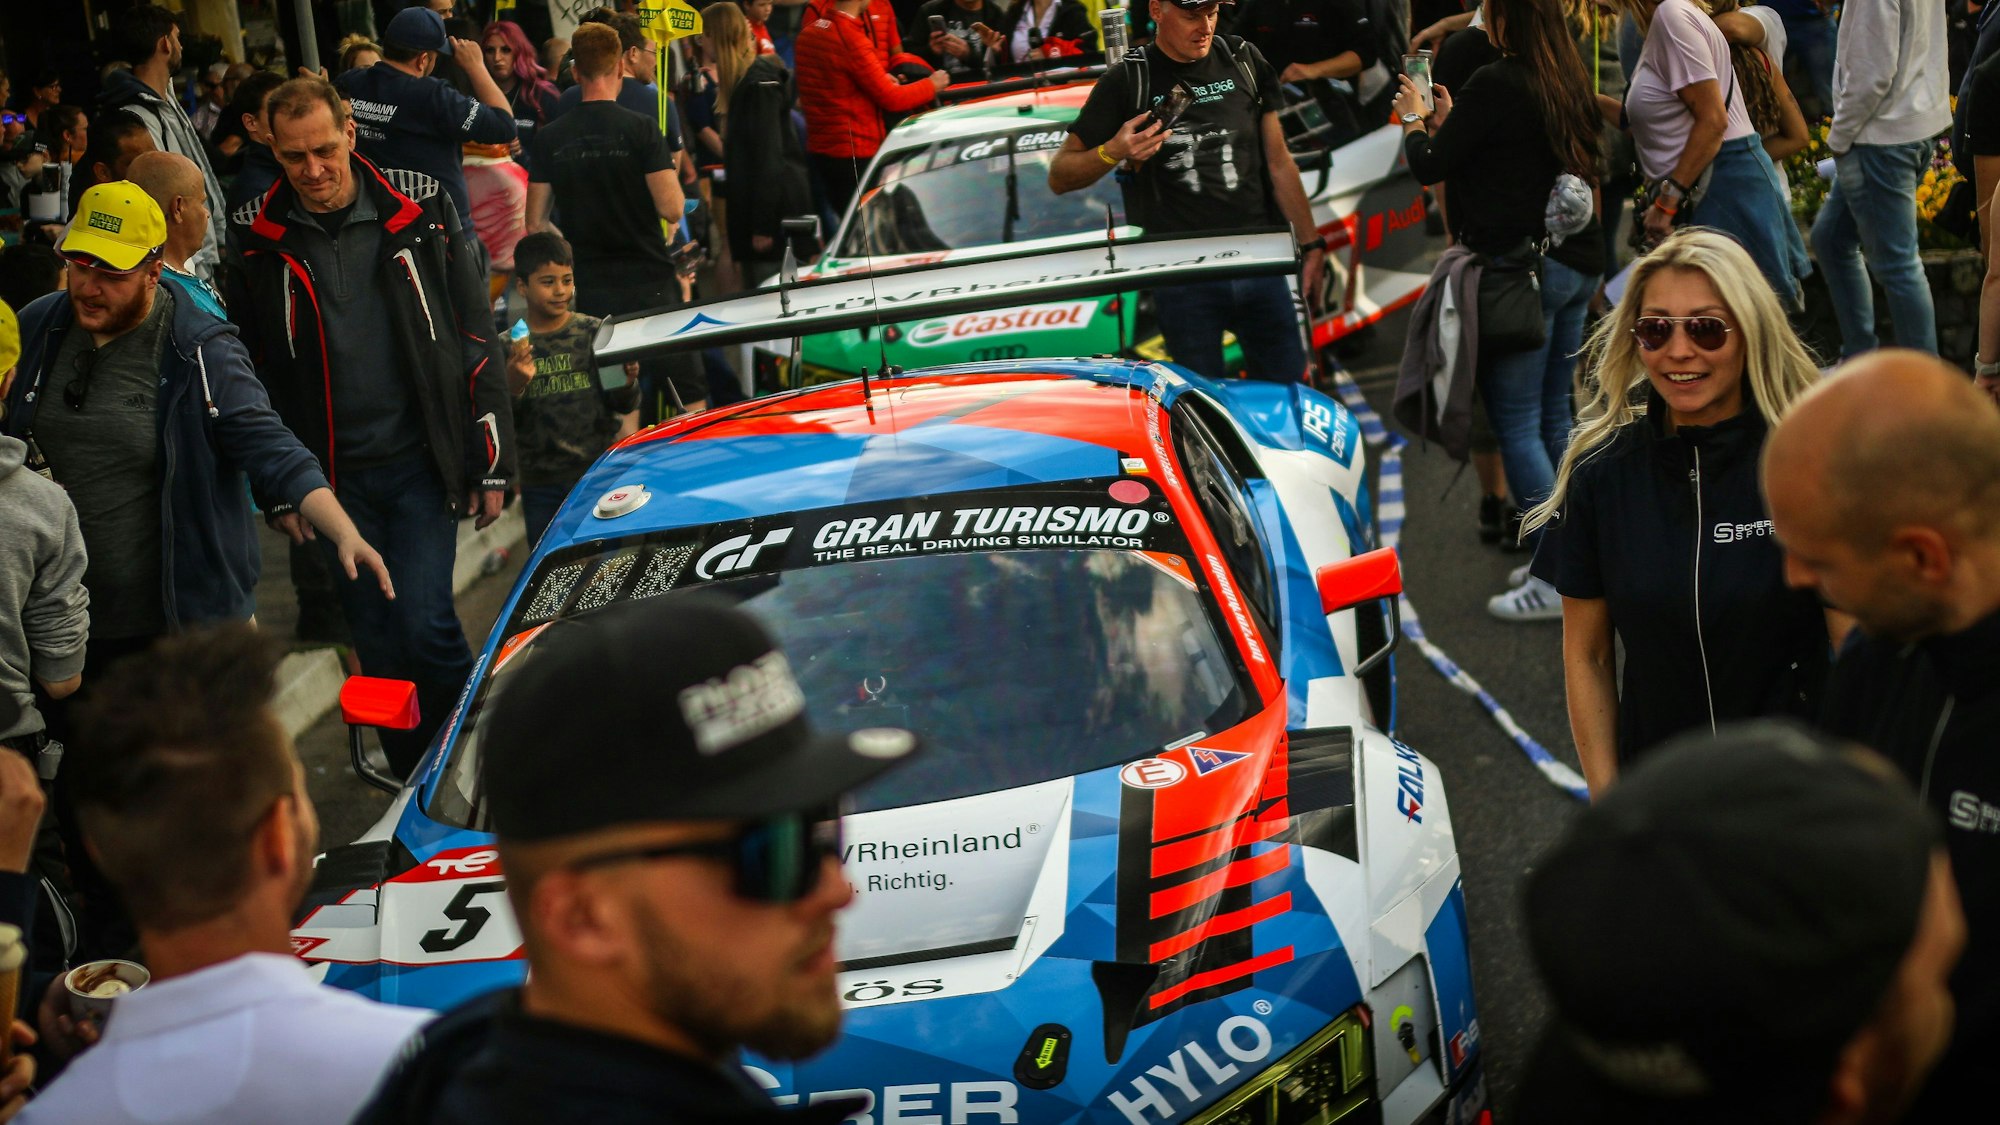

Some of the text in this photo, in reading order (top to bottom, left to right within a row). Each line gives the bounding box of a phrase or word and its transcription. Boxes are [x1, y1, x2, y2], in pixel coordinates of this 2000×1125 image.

[88, 218, 120, 233] FILTER
[90, 212, 120, 226] MANN
[952, 304, 1083, 337] Castrol
[1303, 399, 1331, 443] IRS
[812, 510, 942, 549] GRAN
[813, 534, 1144, 562] THE REAL DRIVING SIMULATOR
[867, 870, 953, 892] Richtig.
[419, 880, 508, 953] 5
